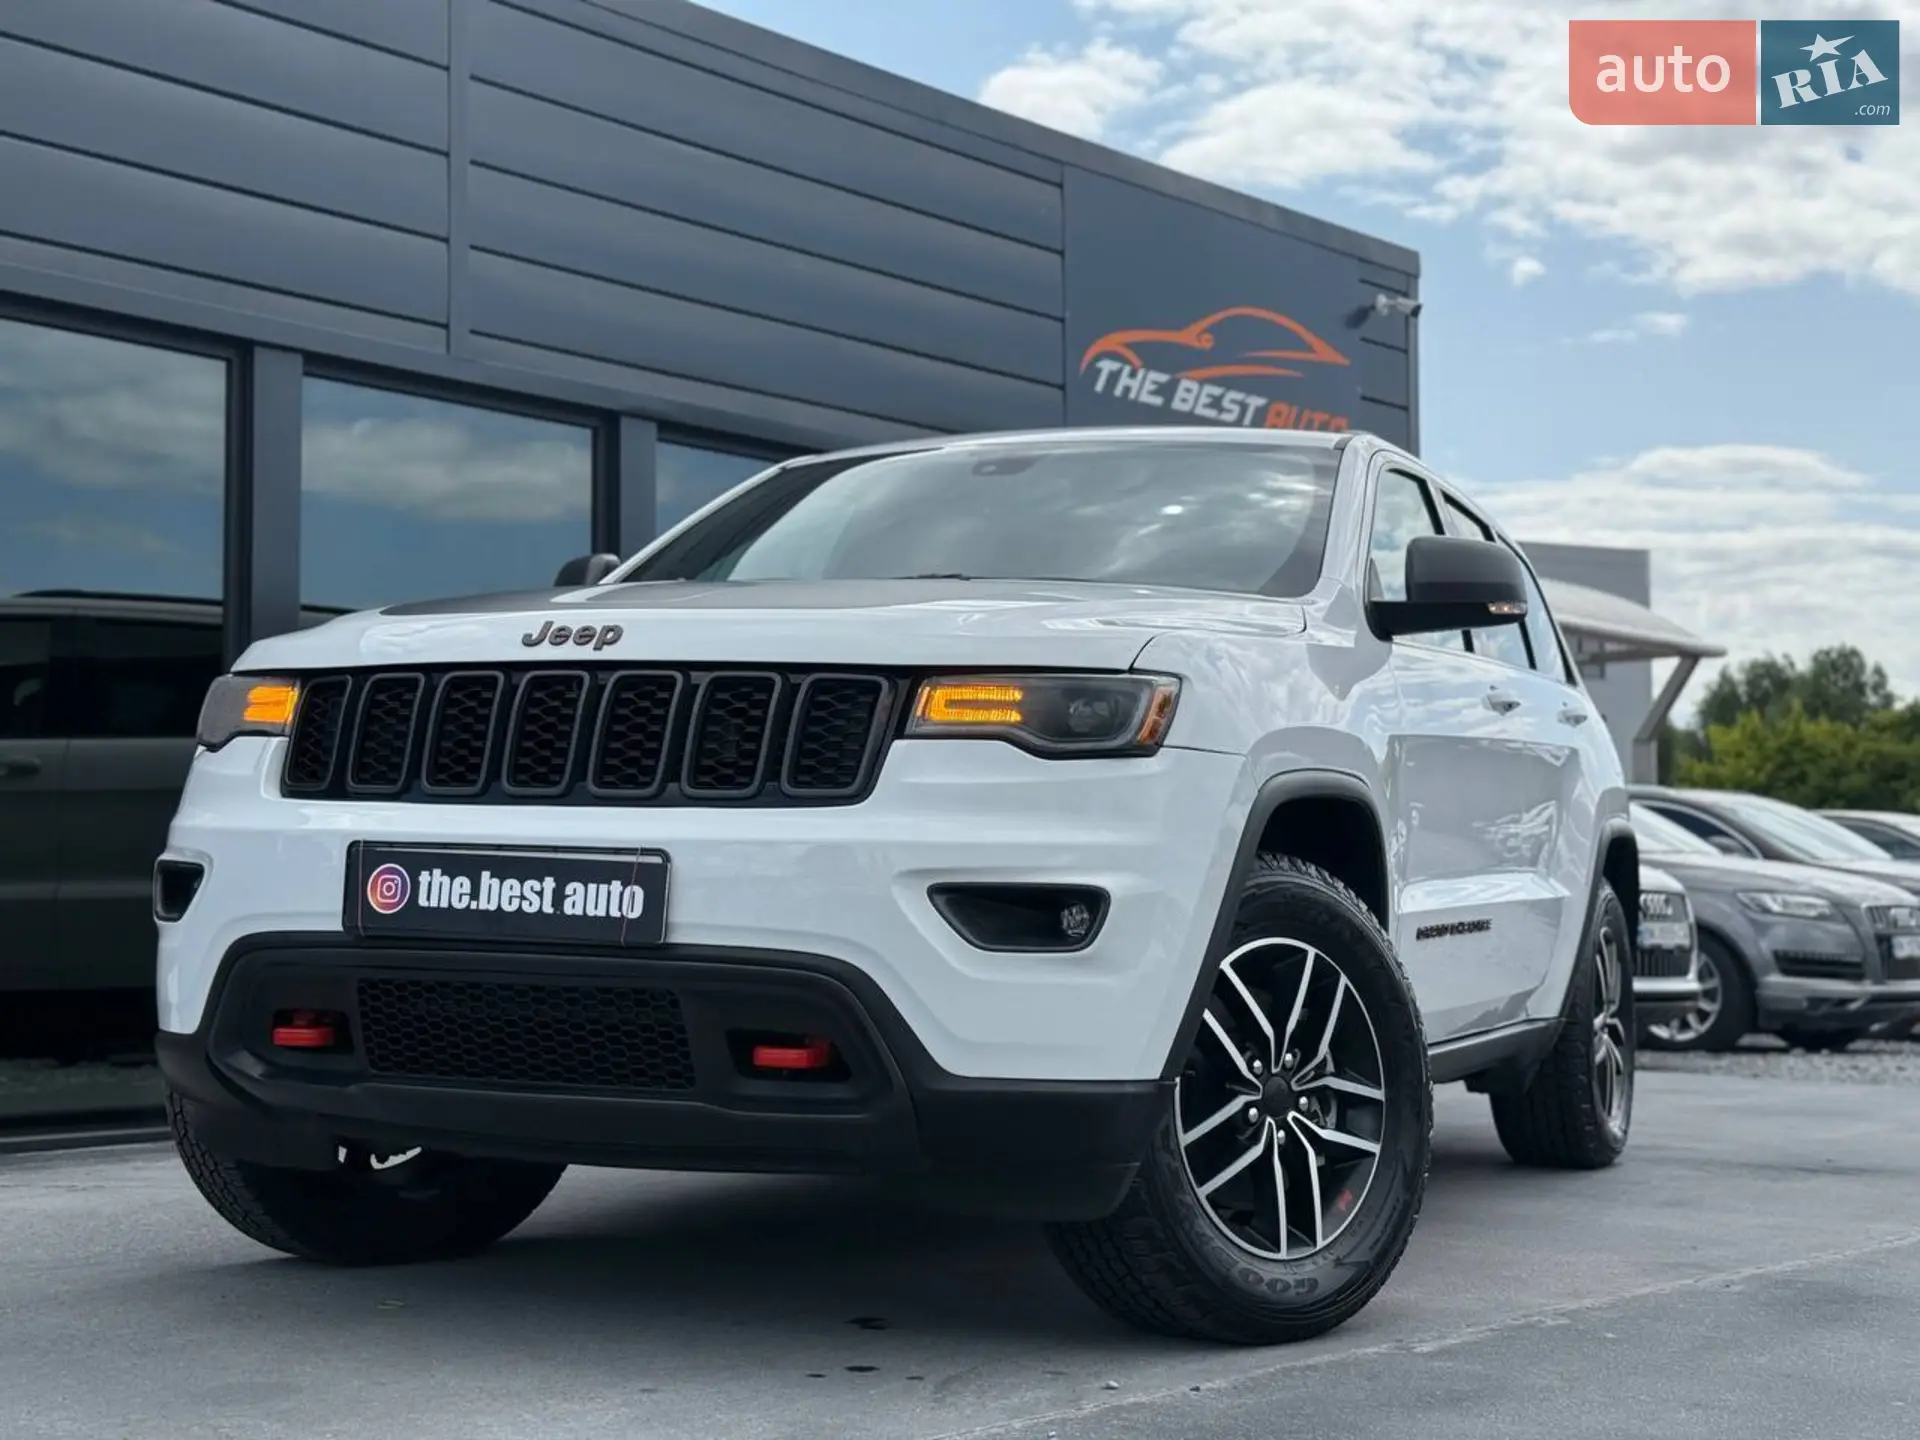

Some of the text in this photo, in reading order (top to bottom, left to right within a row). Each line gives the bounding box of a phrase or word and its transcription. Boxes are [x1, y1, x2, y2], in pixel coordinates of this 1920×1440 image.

[1094, 358, 1172, 408] THE
[1170, 377, 1268, 427] BEST
[521, 620, 624, 651] Jeep
